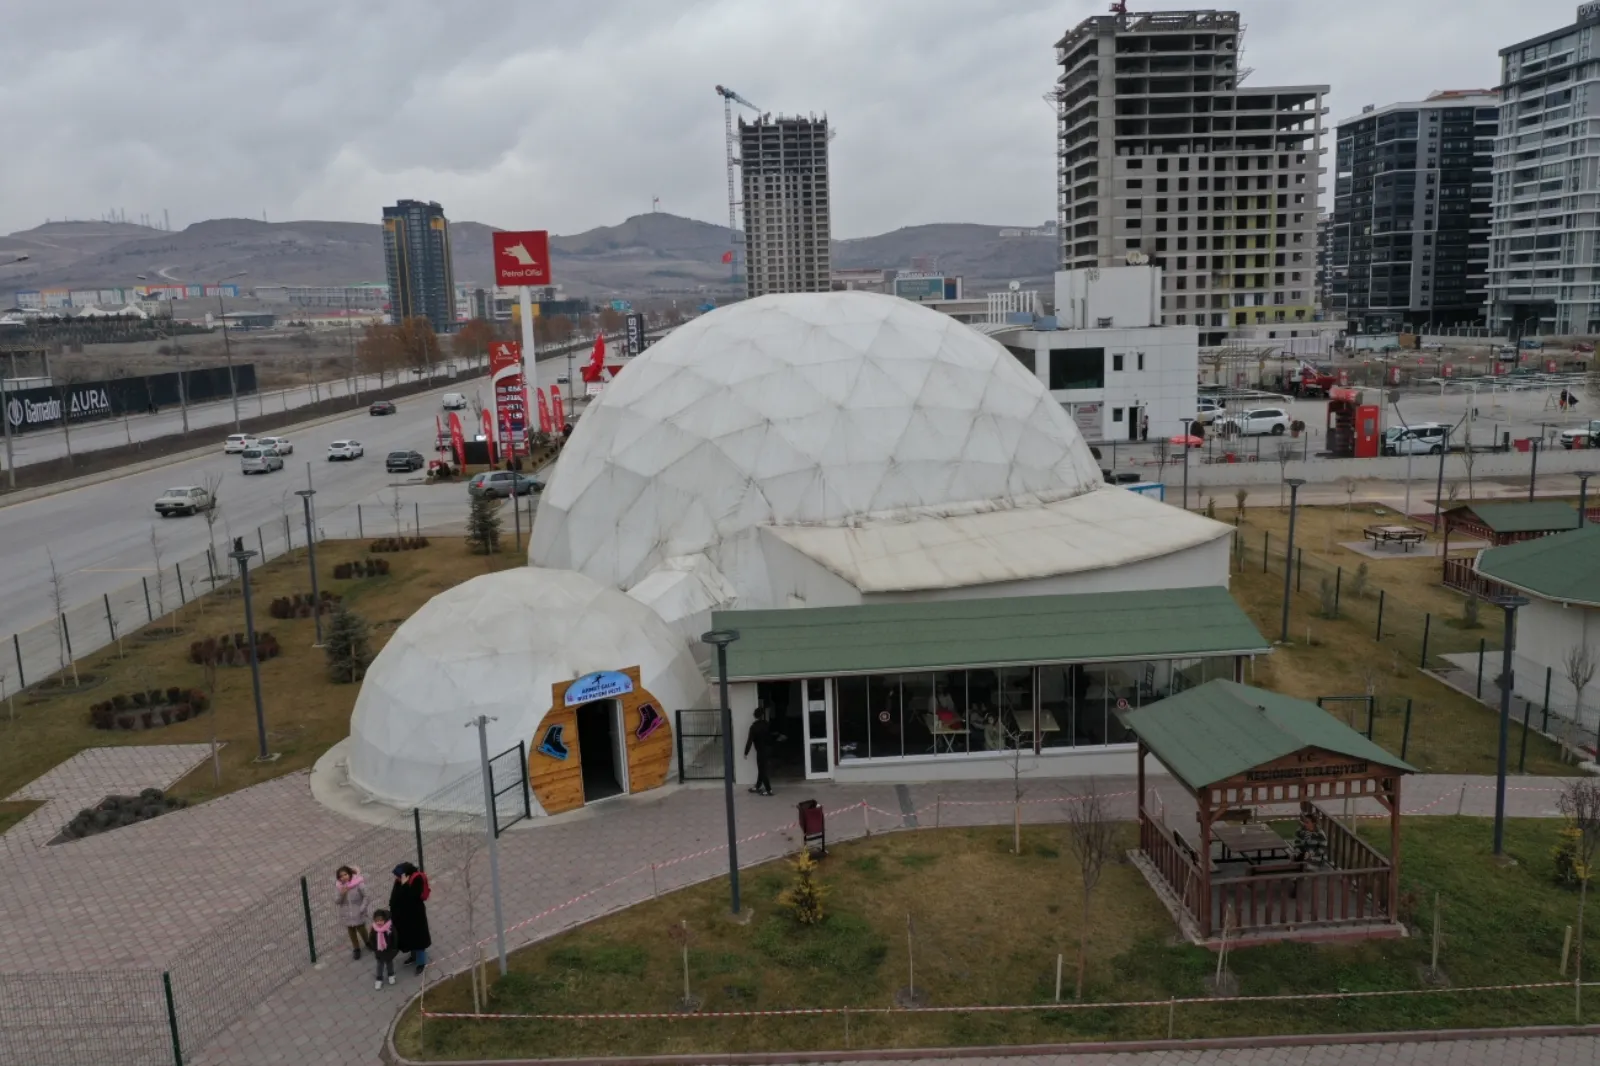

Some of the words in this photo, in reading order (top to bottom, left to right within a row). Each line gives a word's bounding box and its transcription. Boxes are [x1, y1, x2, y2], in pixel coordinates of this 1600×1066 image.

[502, 269, 523, 278] Petrol
[525, 268, 543, 277] Ofisi
[70, 388, 109, 412] AURA
